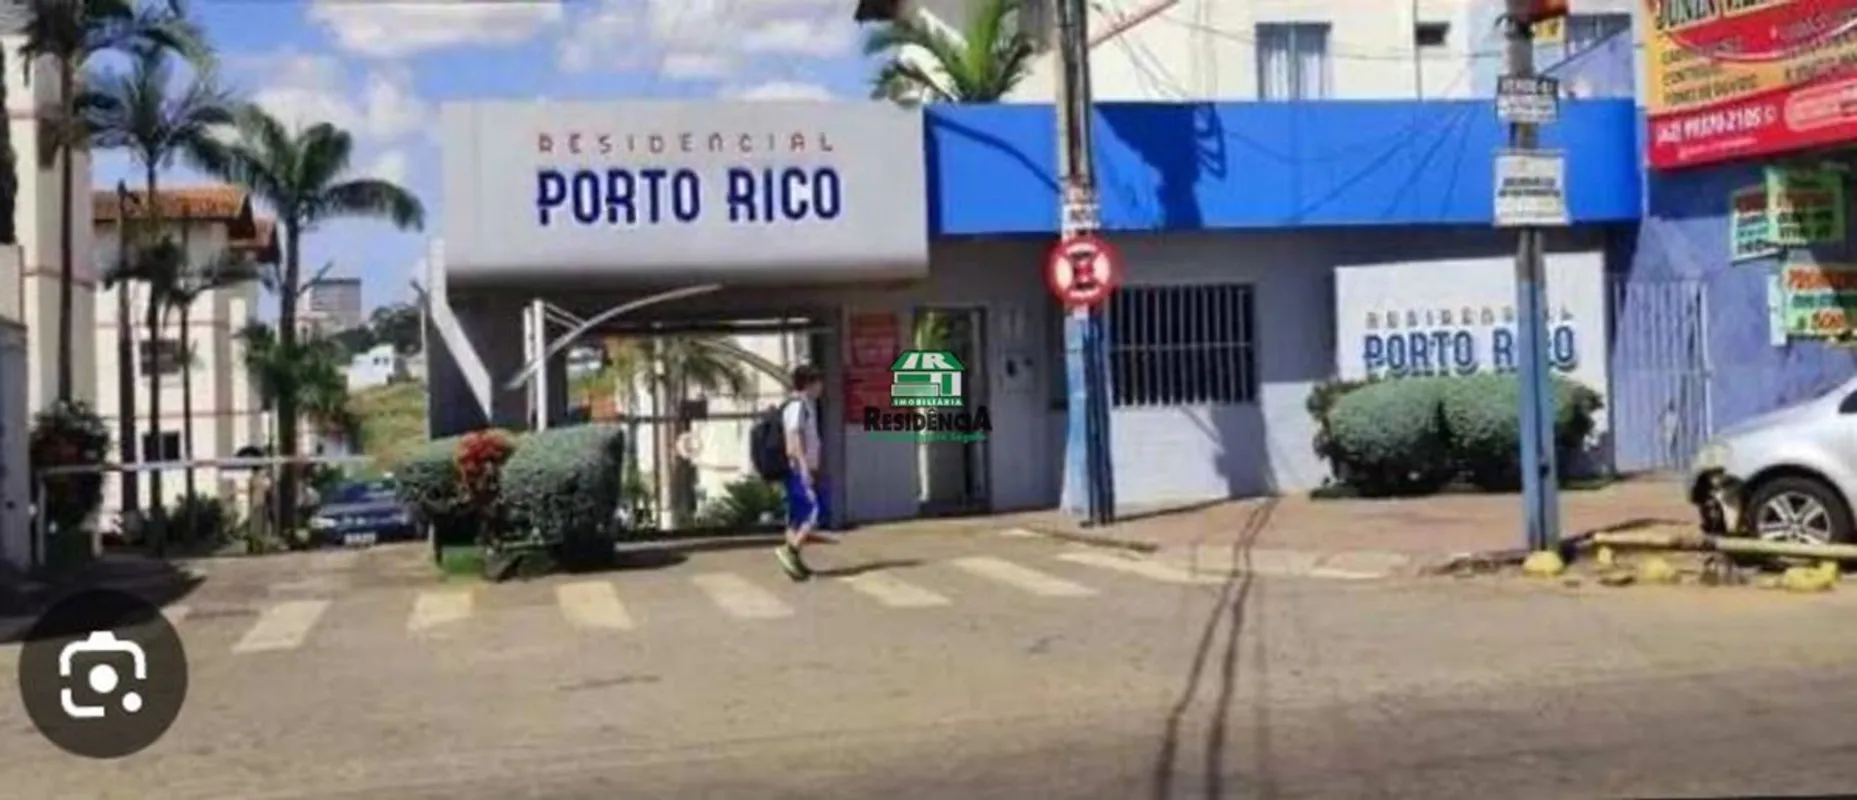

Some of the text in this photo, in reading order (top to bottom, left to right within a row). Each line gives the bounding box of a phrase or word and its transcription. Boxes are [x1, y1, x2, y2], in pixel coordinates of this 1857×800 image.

[538, 132, 835, 153] RESIDENCIAL
[537, 166, 842, 226] PORTO RICO
[1363, 325, 1575, 371] PORTO RO
